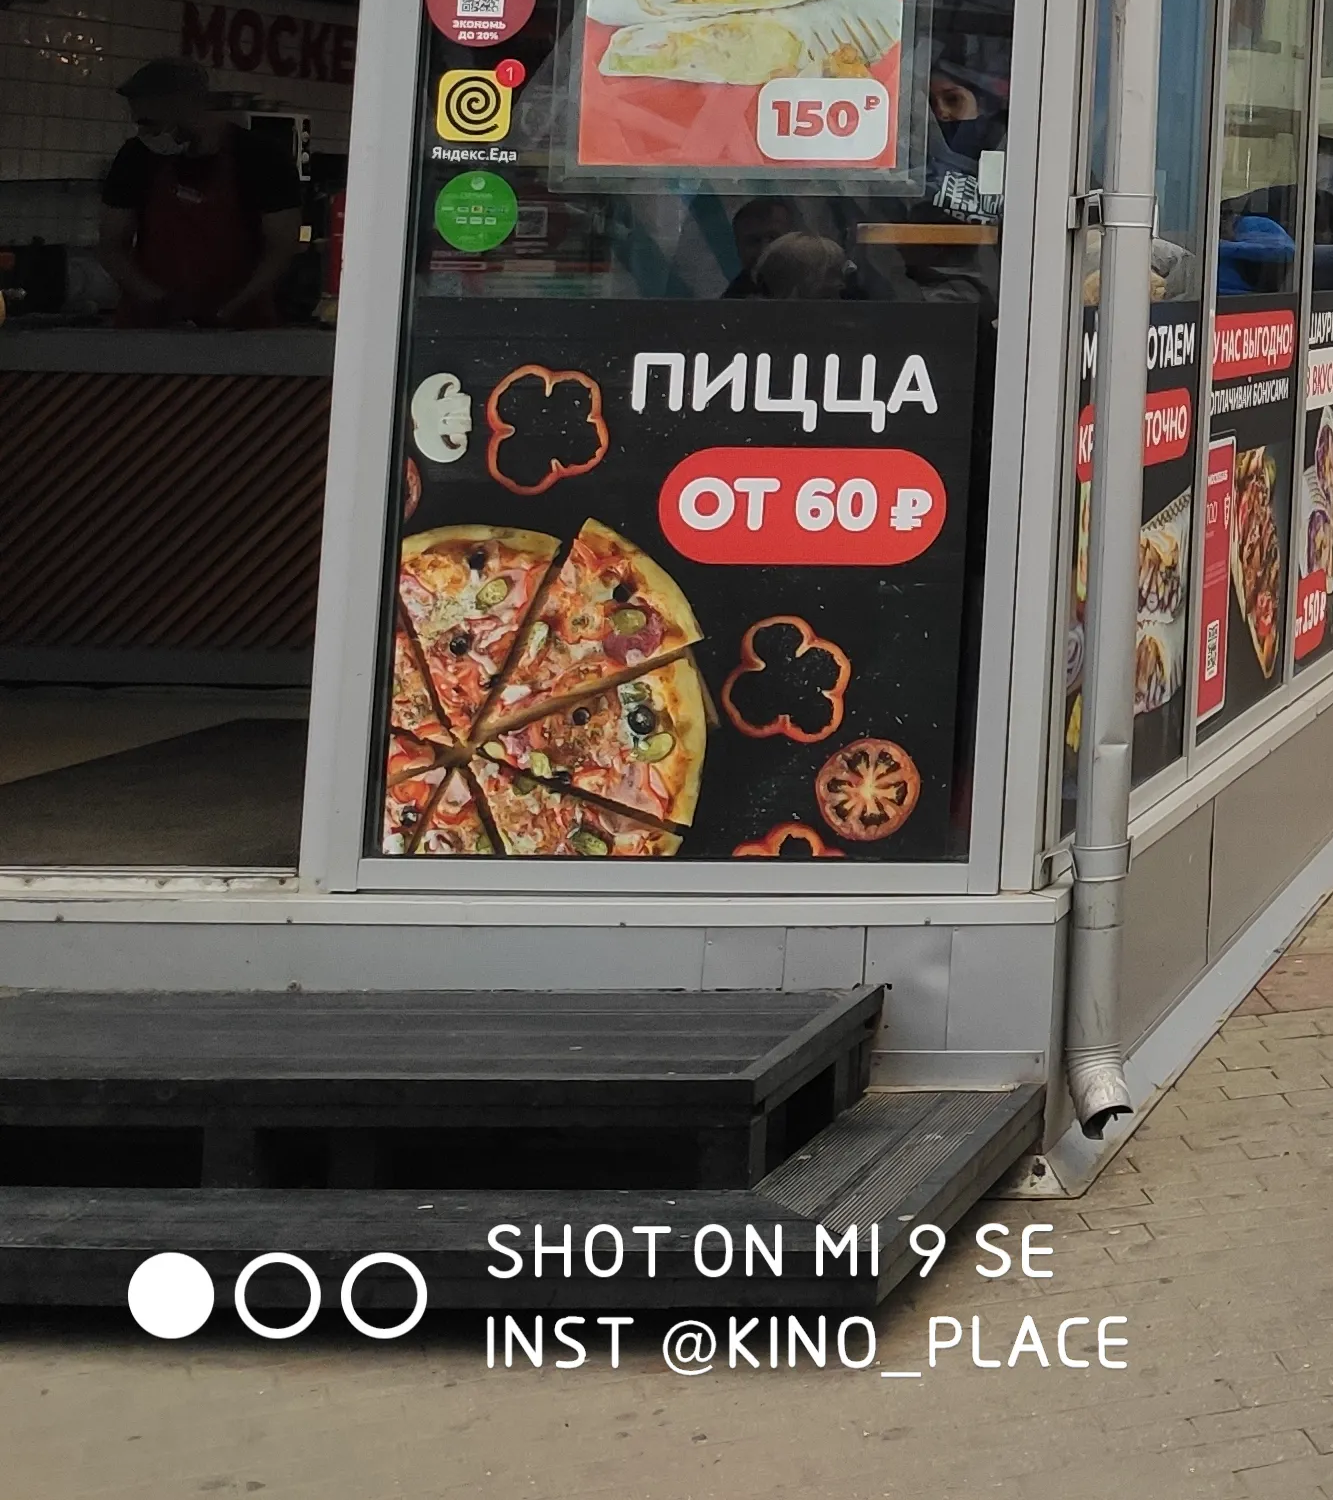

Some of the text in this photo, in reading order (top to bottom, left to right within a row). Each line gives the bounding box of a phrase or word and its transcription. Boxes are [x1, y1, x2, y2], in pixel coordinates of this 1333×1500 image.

[452, 20, 506, 30] ЭКОНОМЬ
[458, 31, 499, 40] ДО 20%
[431, 147, 517, 163] Яндекс.Еда
[1220, 328, 1242, 363] НАС
[1242, 323, 1293, 366] ВЫГОДНО!
[630, 352, 939, 433] ПИЦЦА
[1252, 377, 1289, 407] БОНУСАМИ
[678, 476, 780, 531] ОТ
[795, 477, 878, 532] 60
